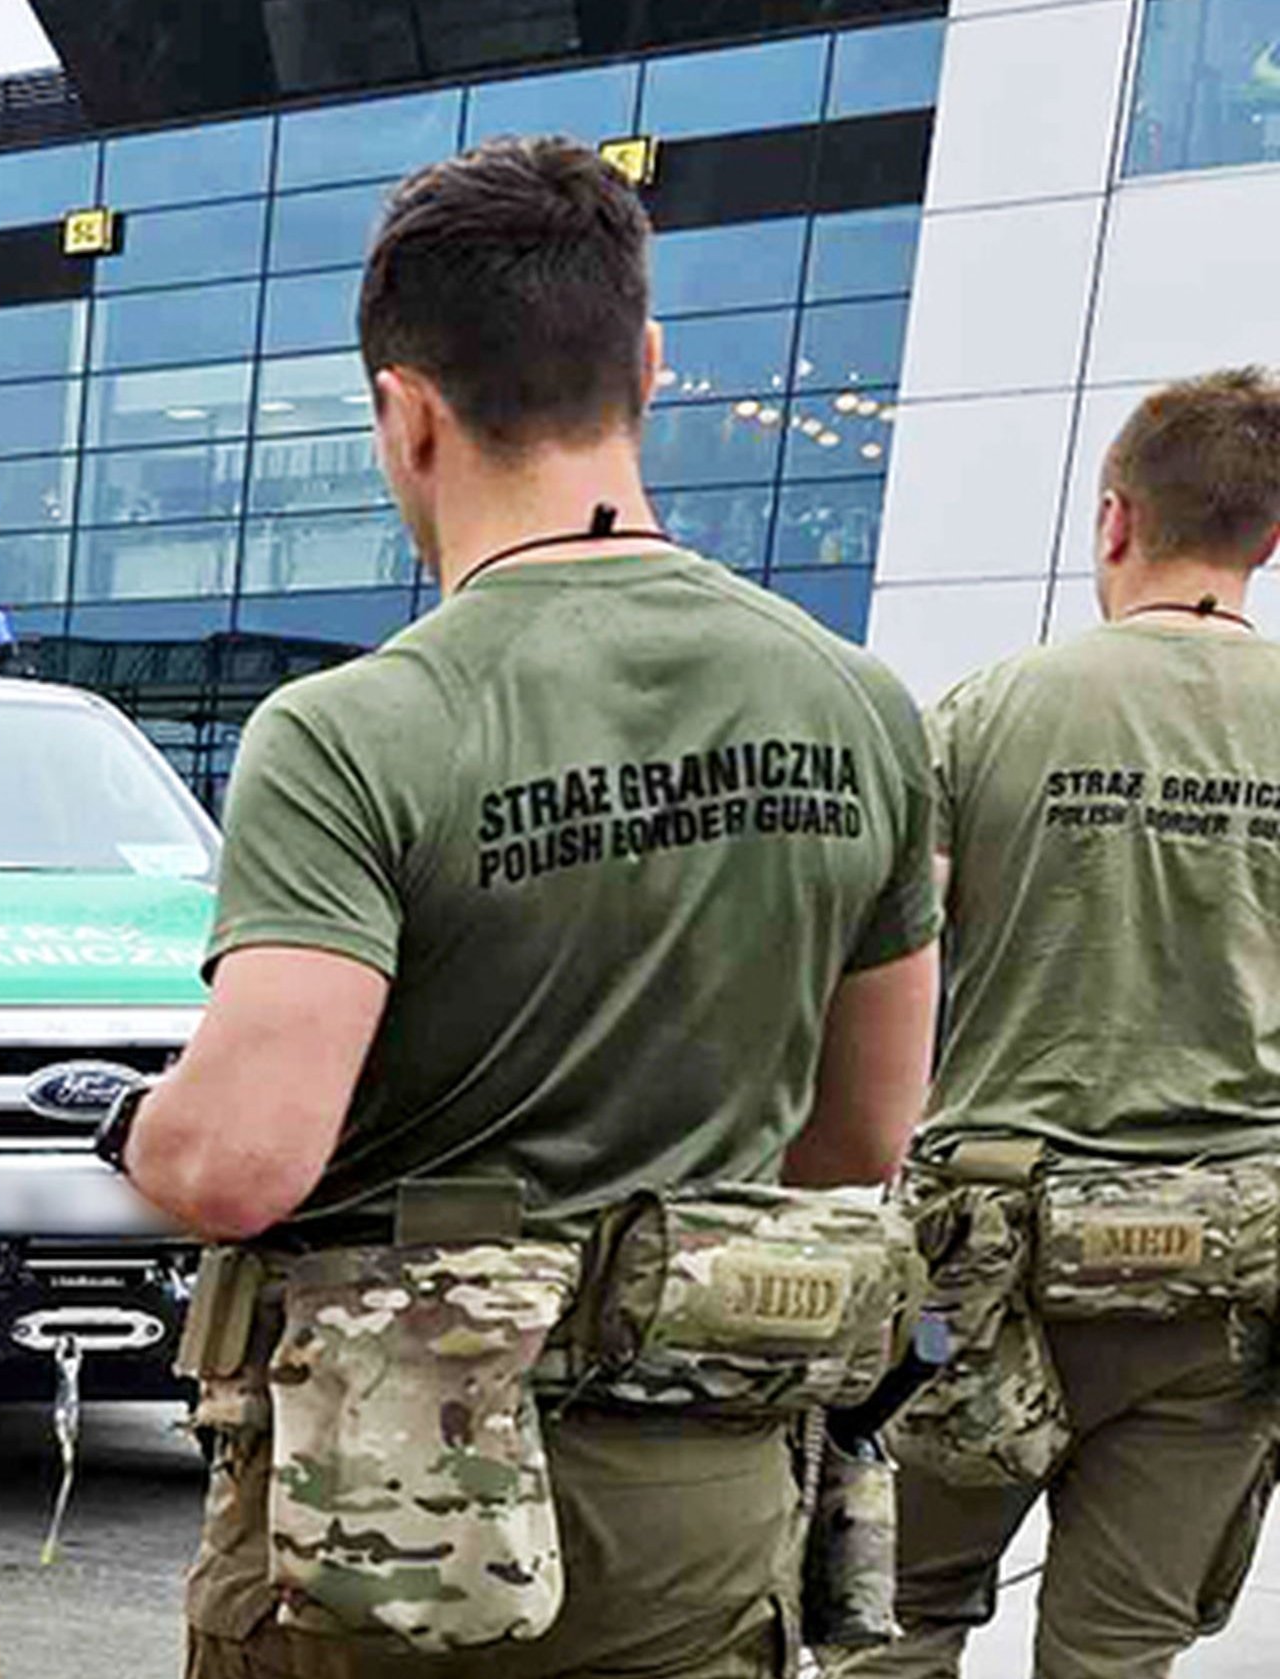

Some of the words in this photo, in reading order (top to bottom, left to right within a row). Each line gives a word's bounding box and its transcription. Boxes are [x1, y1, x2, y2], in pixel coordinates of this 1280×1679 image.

[620, 740, 860, 810] GRANICZNA
[479, 823, 604, 889] POLISH
[753, 795, 862, 838] GUARD
[1046, 805, 1127, 827] POLISH
[1145, 808, 1231, 836] BORDER
[1247, 815, 1280, 842] GU
[54, 1072, 122, 1104] Ford
[1104, 1224, 1189, 1257] MED
[729, 1273, 837, 1320] MED
